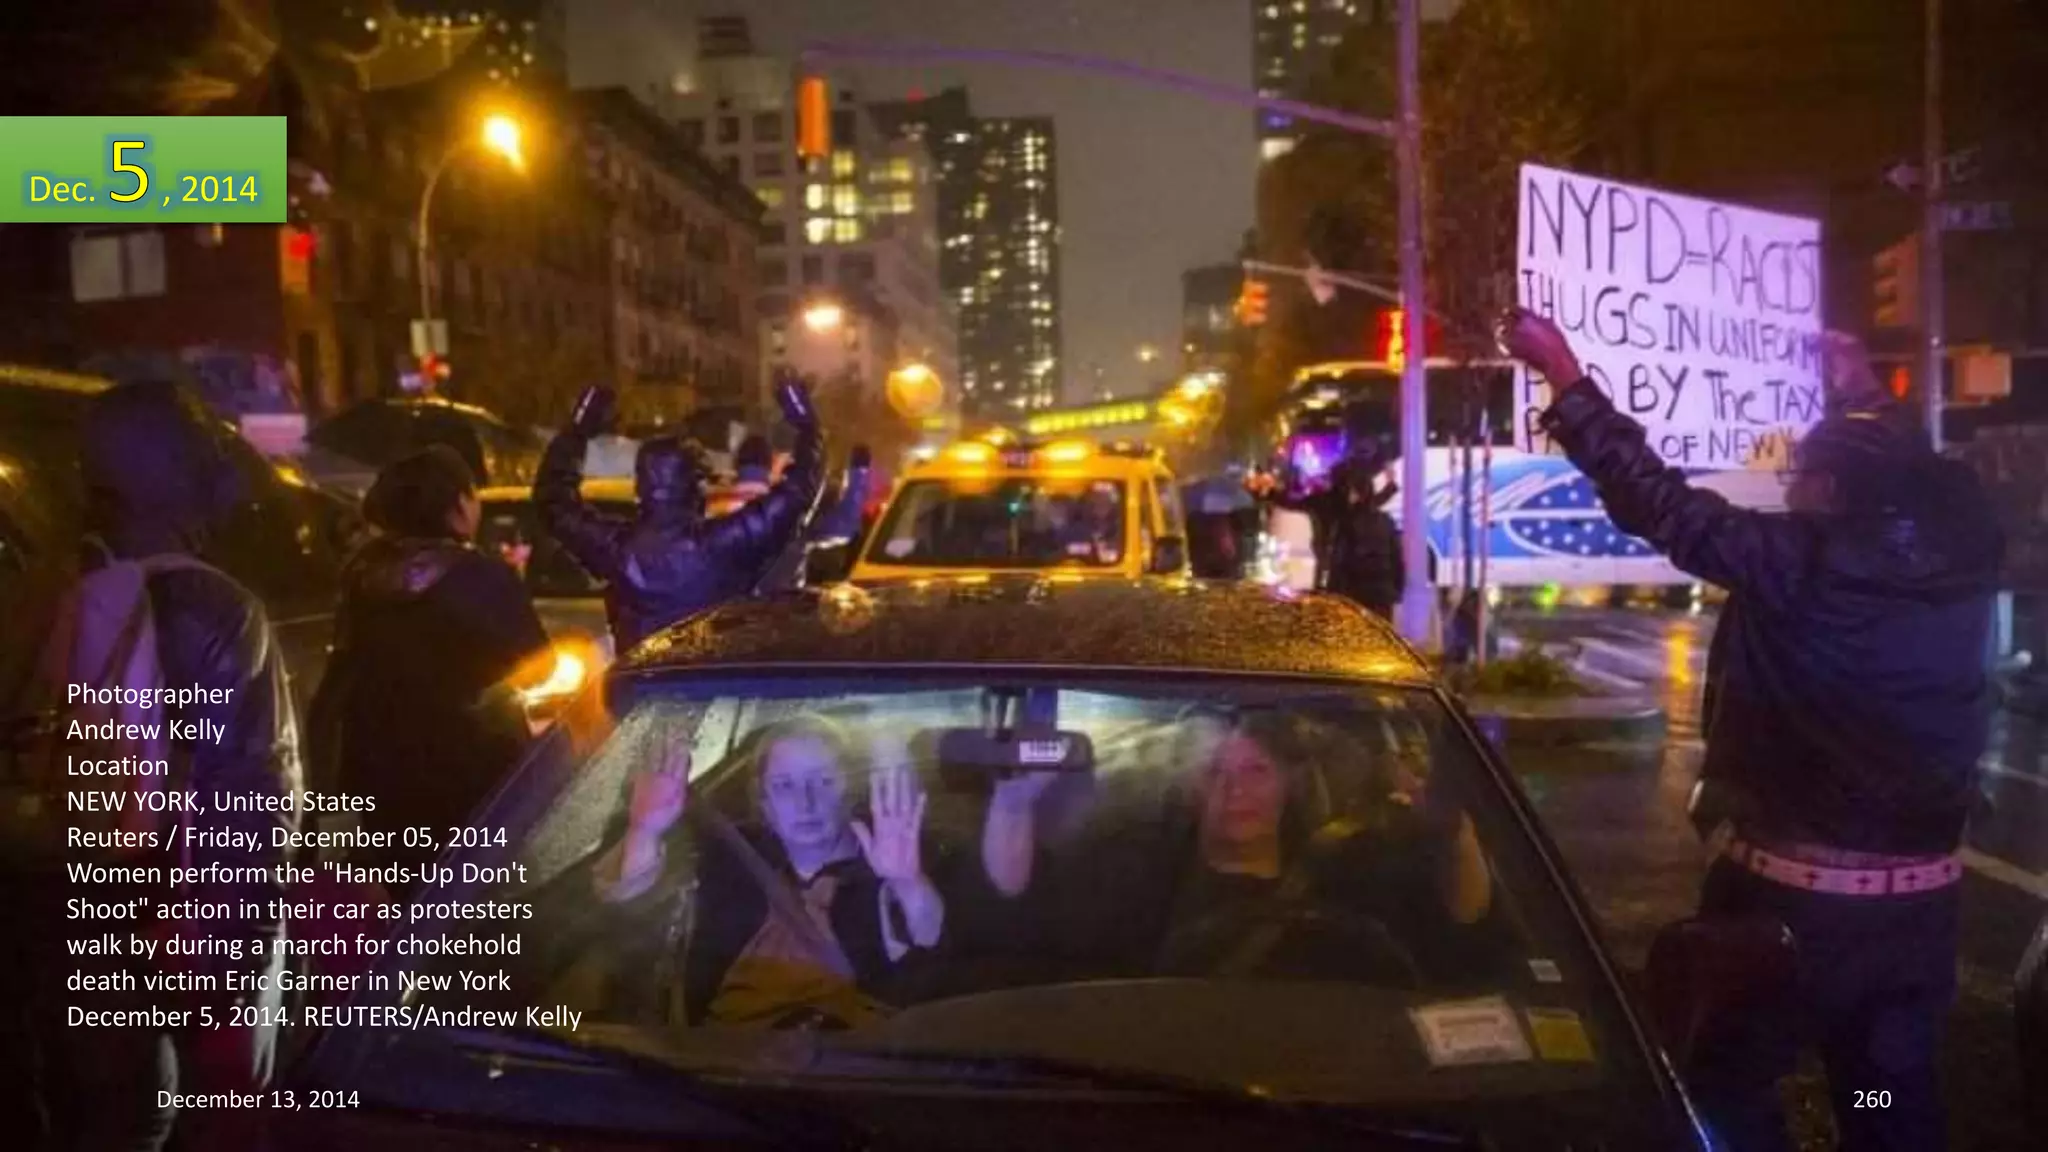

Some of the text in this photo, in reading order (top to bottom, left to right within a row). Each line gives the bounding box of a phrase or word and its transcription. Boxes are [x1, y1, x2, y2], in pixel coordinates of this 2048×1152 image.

[1664, 303, 1700, 353] IN
[1629, 363, 1690, 420] BY
[1764, 379, 1824, 422] TAX
[1660, 434, 1699, 463] OF
